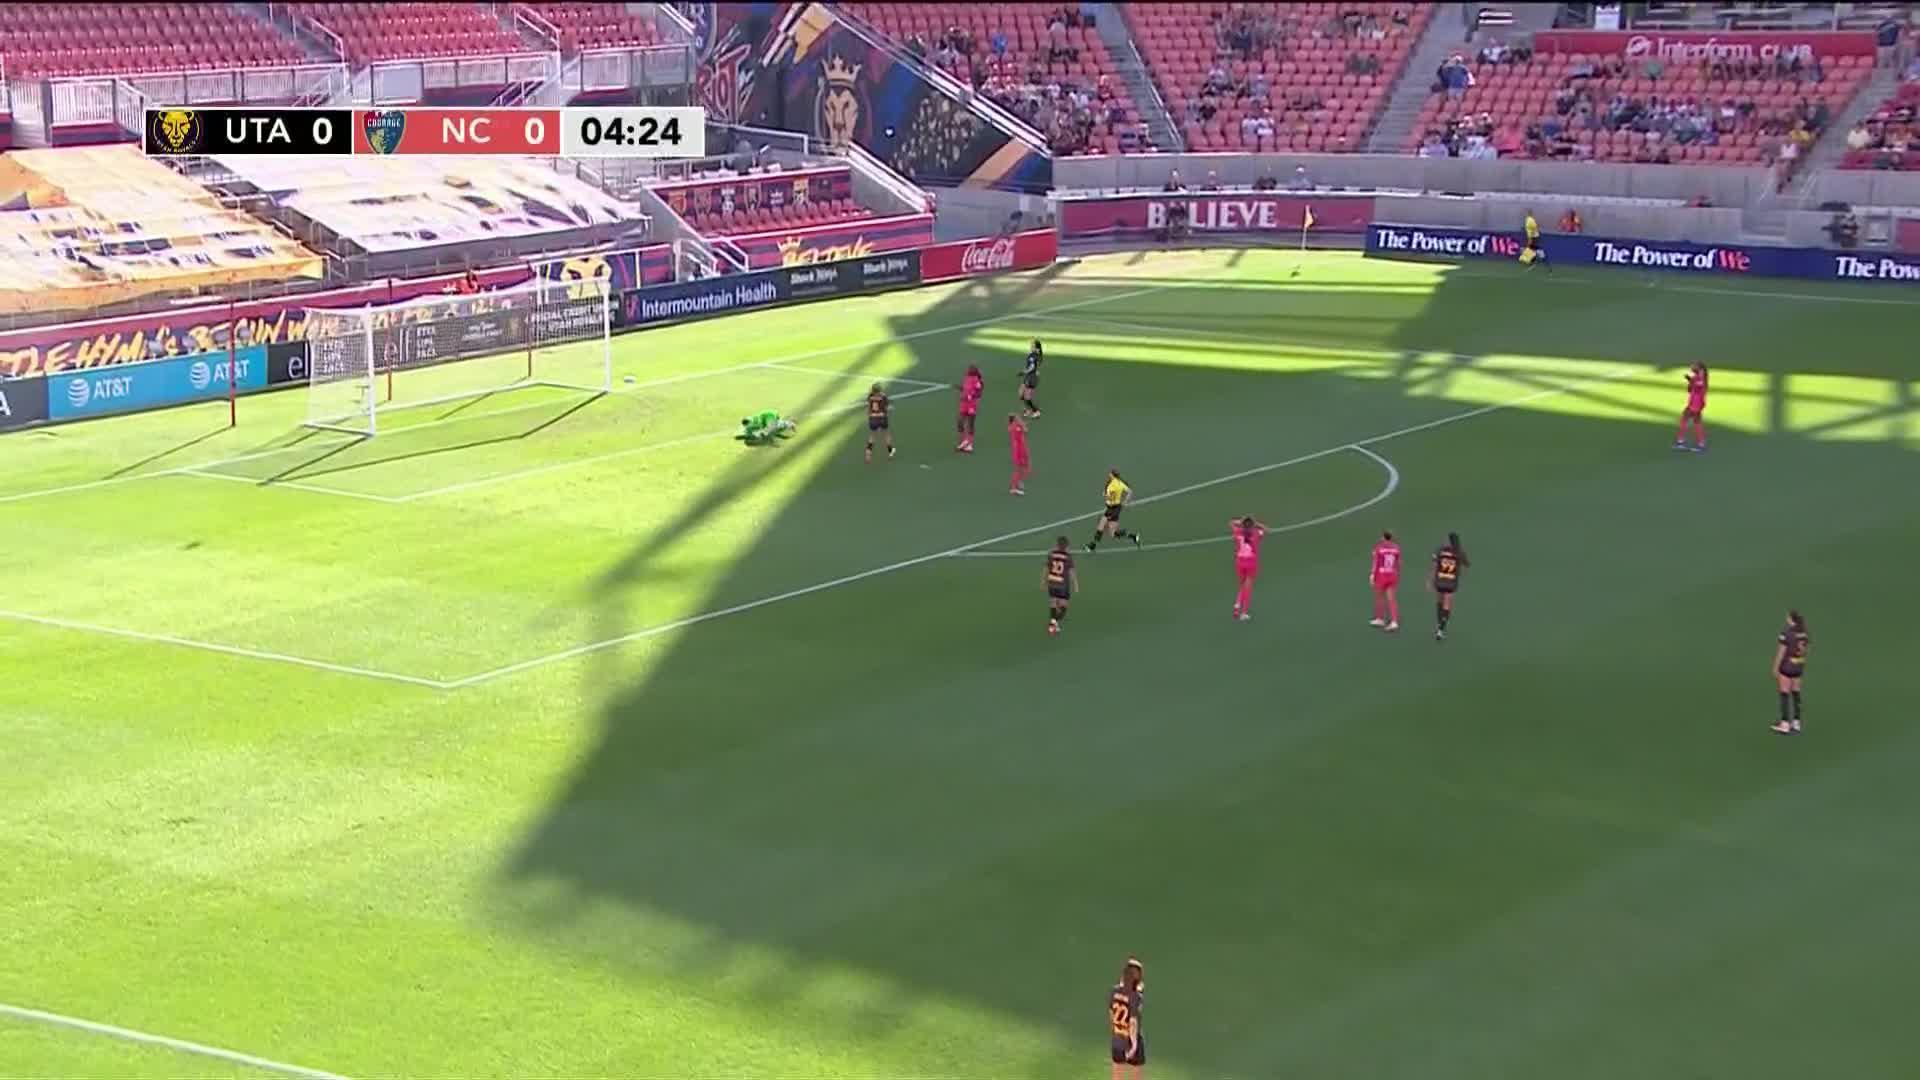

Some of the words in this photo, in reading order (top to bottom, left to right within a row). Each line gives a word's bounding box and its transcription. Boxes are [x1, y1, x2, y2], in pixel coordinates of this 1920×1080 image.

[1147, 201, 1277, 229] BLIEVE
[1377, 229, 1408, 249] The
[1411, 231, 1466, 253] Power
[1467, 234, 1489, 254] of
[1491, 236, 1520, 256] We
[1594, 243, 1630, 263] The
[1632, 245, 1692, 267] Power
[1693, 248, 1717, 269] of
[1719, 249, 1751, 271] We
[1836, 256, 1876, 277] The
[642, 291, 733, 318] Intermountain
[735, 280, 777, 305] Health
[213, 359, 250, 382] AT&T
[94, 375, 133, 399] AT&T
